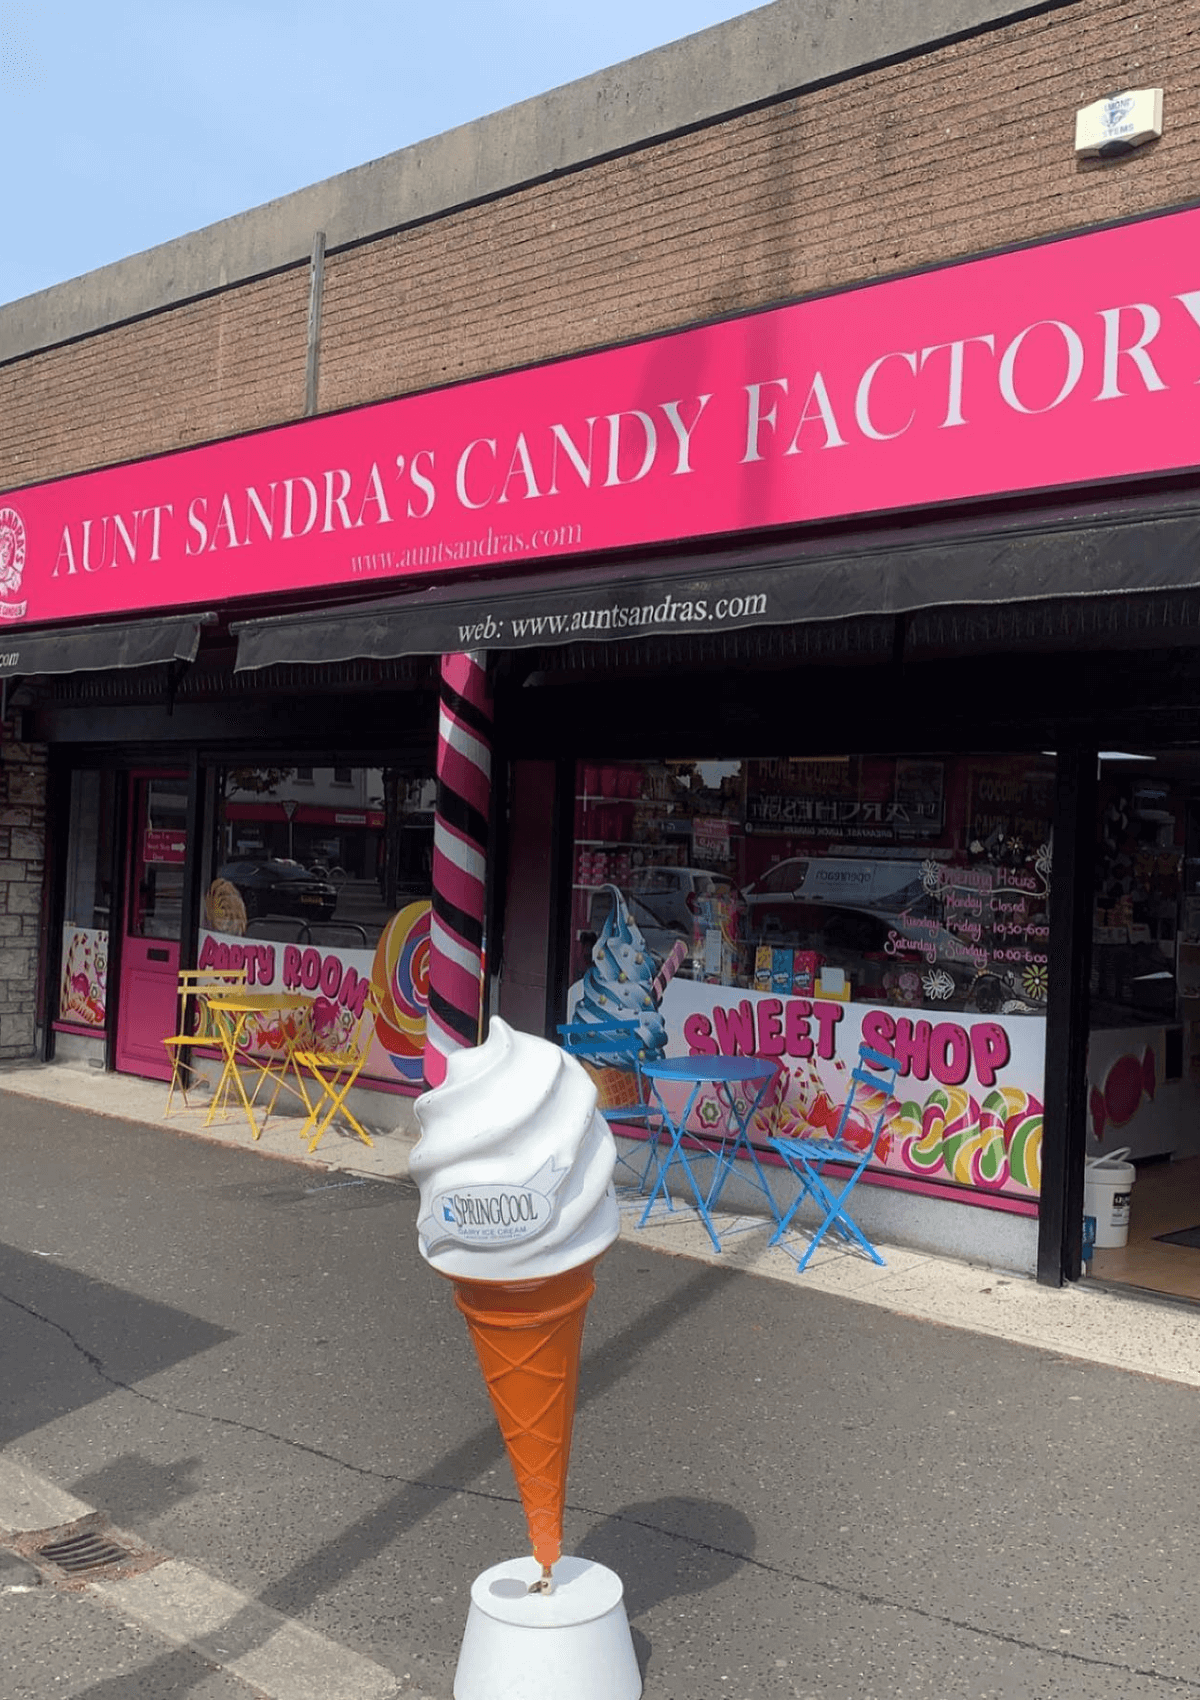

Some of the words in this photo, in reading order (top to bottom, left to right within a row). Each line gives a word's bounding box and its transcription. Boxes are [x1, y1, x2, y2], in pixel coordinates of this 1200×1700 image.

[52, 504, 172, 578] AUNT
[185, 450, 436, 556] SANDRA'S
[456, 394, 714, 510] CANDY
[351, 523, 583, 573] www.auntsandras.com
[458, 614, 504, 643] web:
[512, 593, 768, 638] www.auntsandras.com
[996, 867, 1036, 889] Hours
[946, 893, 982, 917] Monday
[990, 897, 1026, 913] Closed
[946, 910, 982, 942] Friday
[884, 930, 937, 965] Saturday
[945, 940, 988, 969] Sunday
[283, 942, 370, 1021] ROOM
[683, 998, 845, 1060] SWEET
[861, 1009, 1012, 1088] SHOP
[453, 1193, 538, 1228] SPRINGCOOL
[497, 1226, 526, 1235] CREAM
